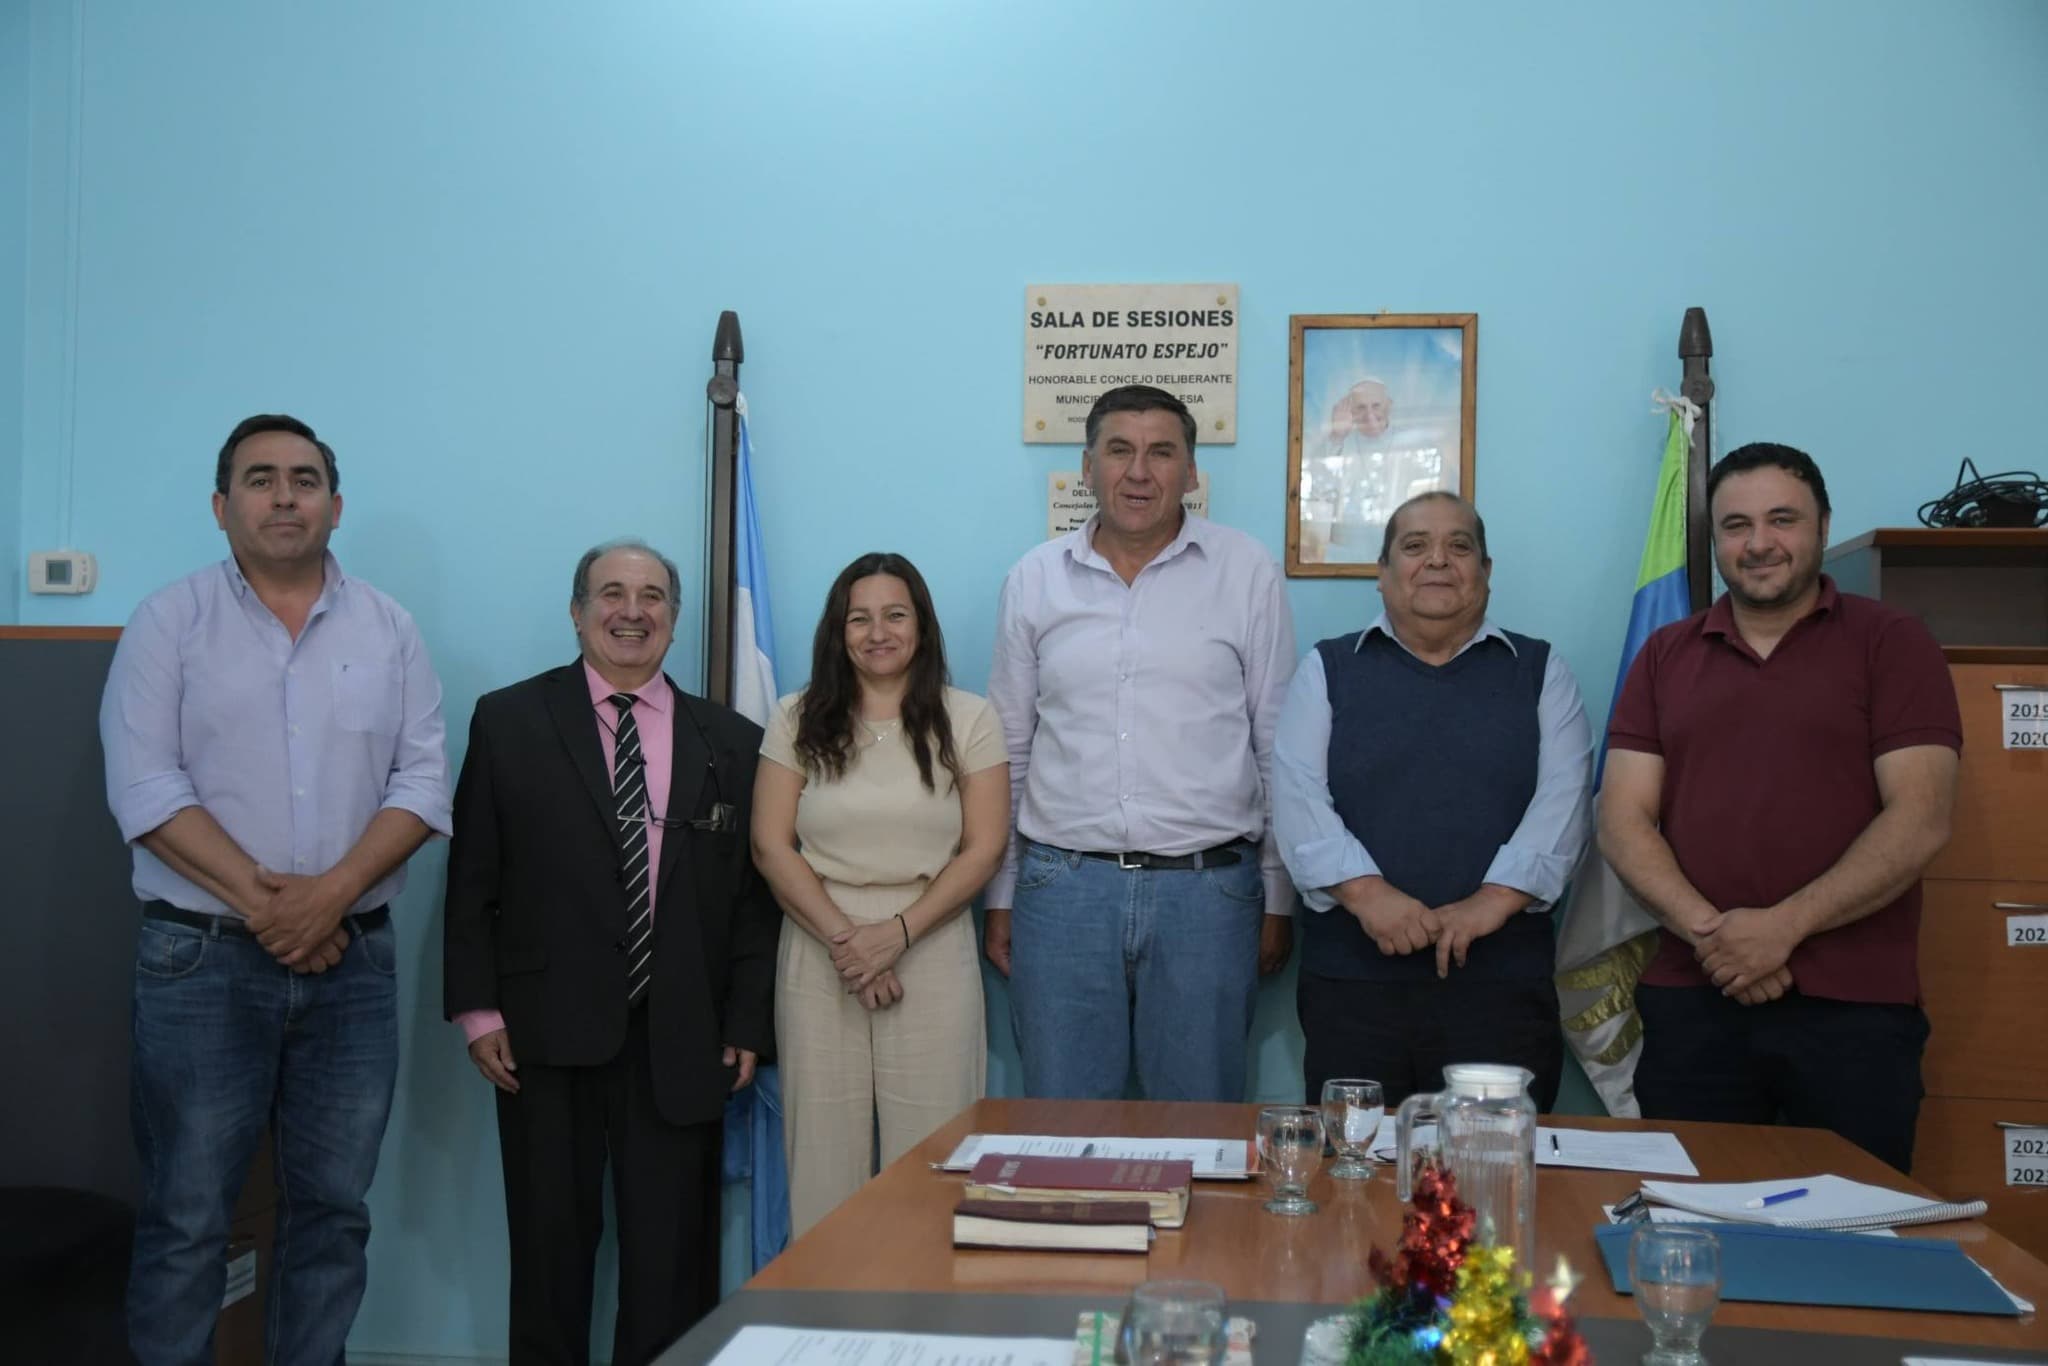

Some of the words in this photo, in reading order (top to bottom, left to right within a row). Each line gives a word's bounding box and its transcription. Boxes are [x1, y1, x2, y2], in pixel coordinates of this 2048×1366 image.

[1030, 311, 1085, 328] SALA
[1092, 311, 1120, 327] DE
[1127, 309, 1234, 328] SESIONES
[1036, 343, 1148, 360] “FORTUNATO
[1153, 342, 1229, 359] ESPEJO”
[1028, 374, 1097, 385] HONORABLE
[1100, 374, 1153, 385] CONCEJO
[1156, 373, 1233, 385] DELIBERANTE
[1177, 394, 1204, 404] ESIA
[2015, 927, 2047, 942] 202
[2012, 1140, 2048, 1154] 202
[2013, 1168, 2048, 1183] 202
